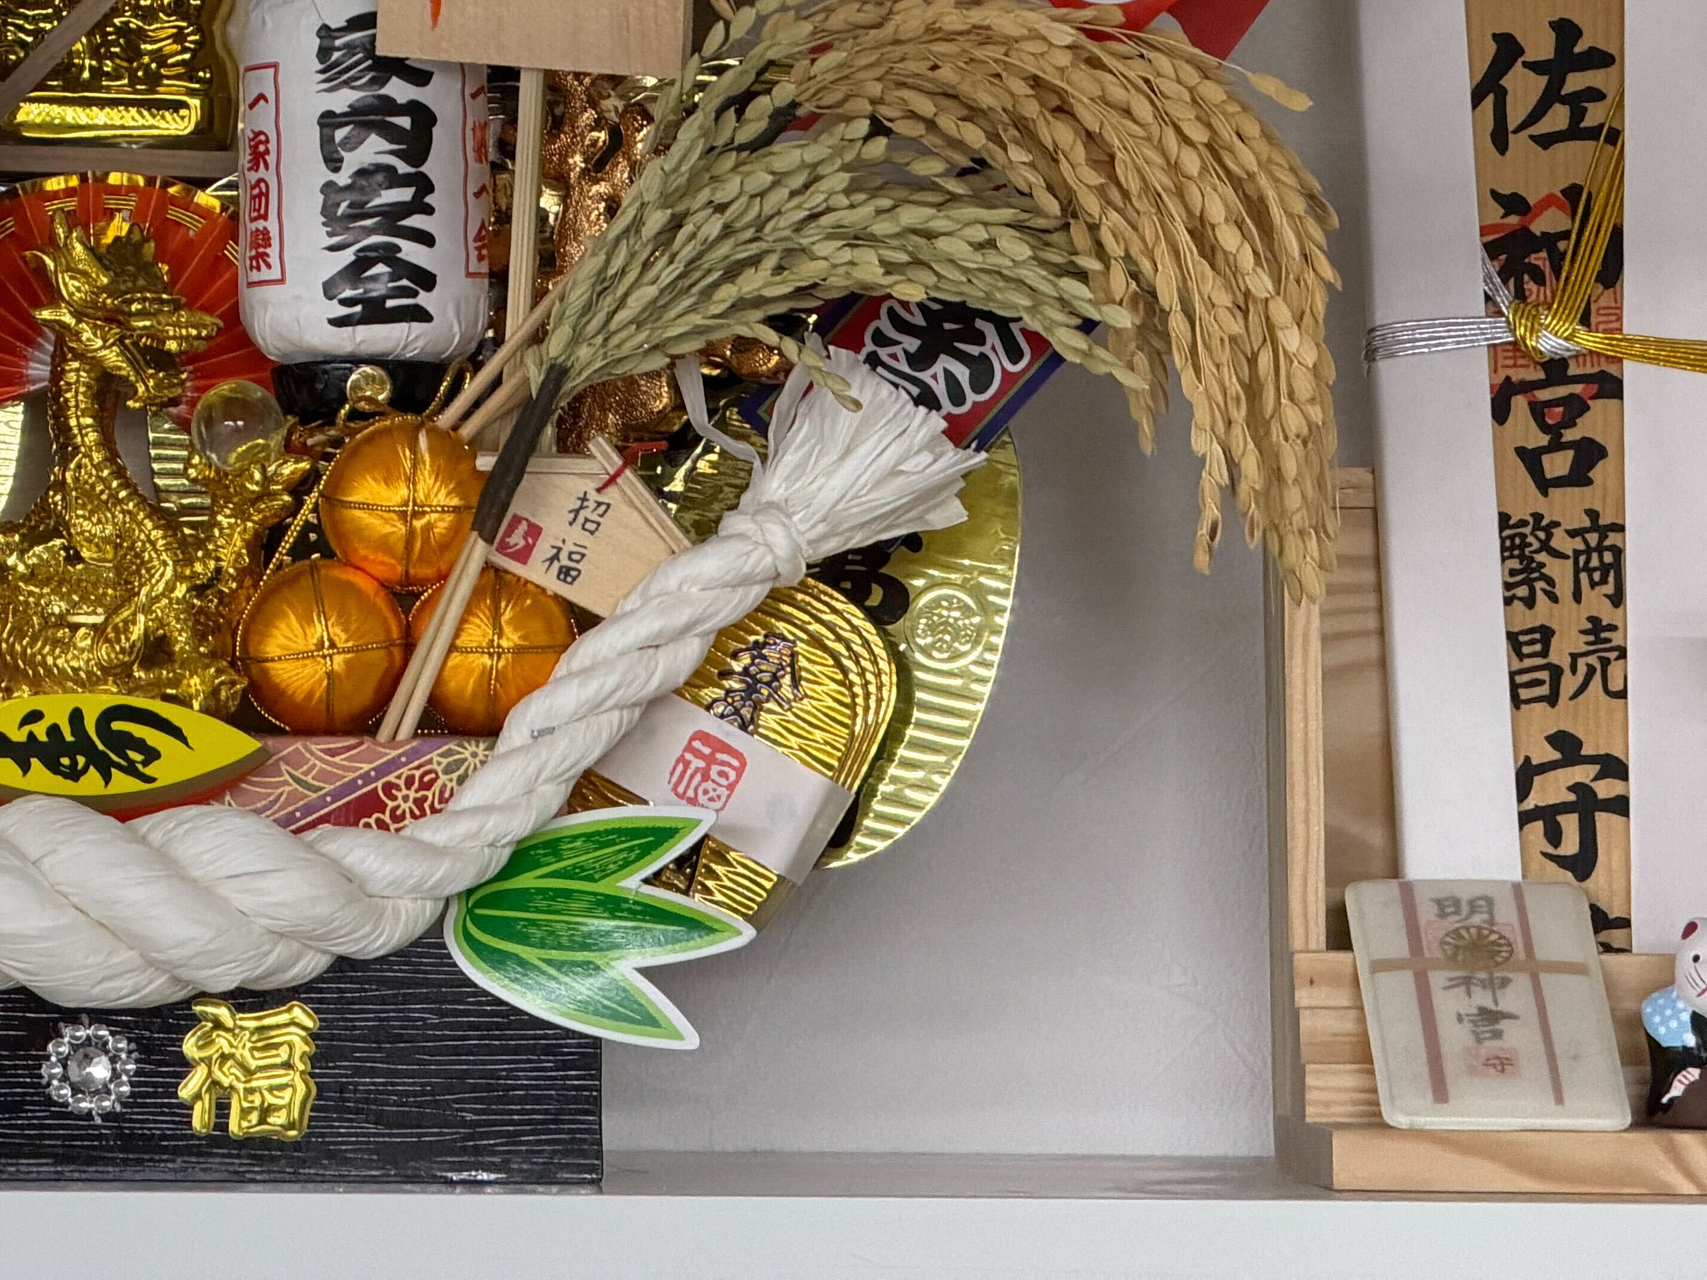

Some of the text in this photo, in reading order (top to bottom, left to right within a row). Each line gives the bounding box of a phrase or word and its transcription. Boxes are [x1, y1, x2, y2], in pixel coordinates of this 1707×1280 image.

[315, 11, 438, 327] 家内安全
[542, 490, 612, 586] 招福
[1498, 511, 1570, 710] 繁昌
[1566, 508, 1627, 701] 商売
[1430, 894, 1520, 1045] 明神宮
[177, 998, 320, 1142] 福
